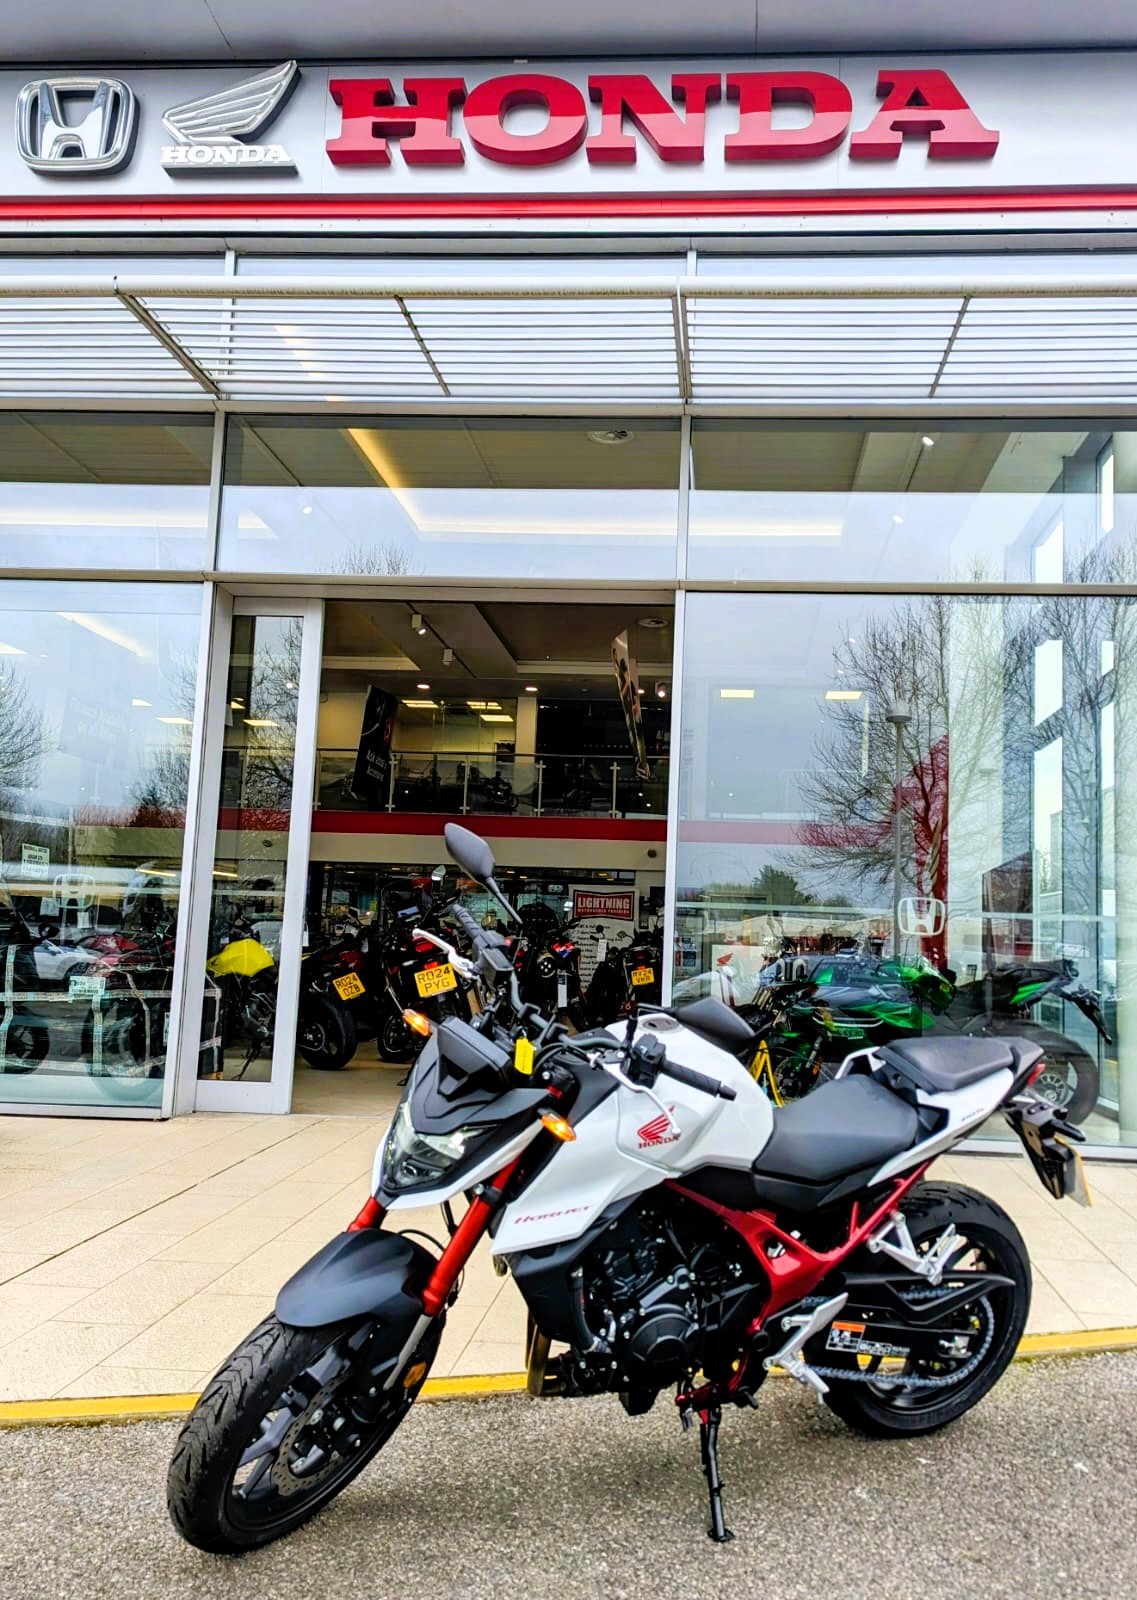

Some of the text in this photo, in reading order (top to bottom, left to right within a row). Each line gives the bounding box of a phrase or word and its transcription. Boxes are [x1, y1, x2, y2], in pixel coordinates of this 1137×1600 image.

[326, 69, 1000, 166] HONDA
[160, 144, 294, 166] HONDA
[577, 897, 630, 909] LIGHTNING
[424, 977, 450, 993] PYG
[638, 1133, 681, 1149] HONDA
